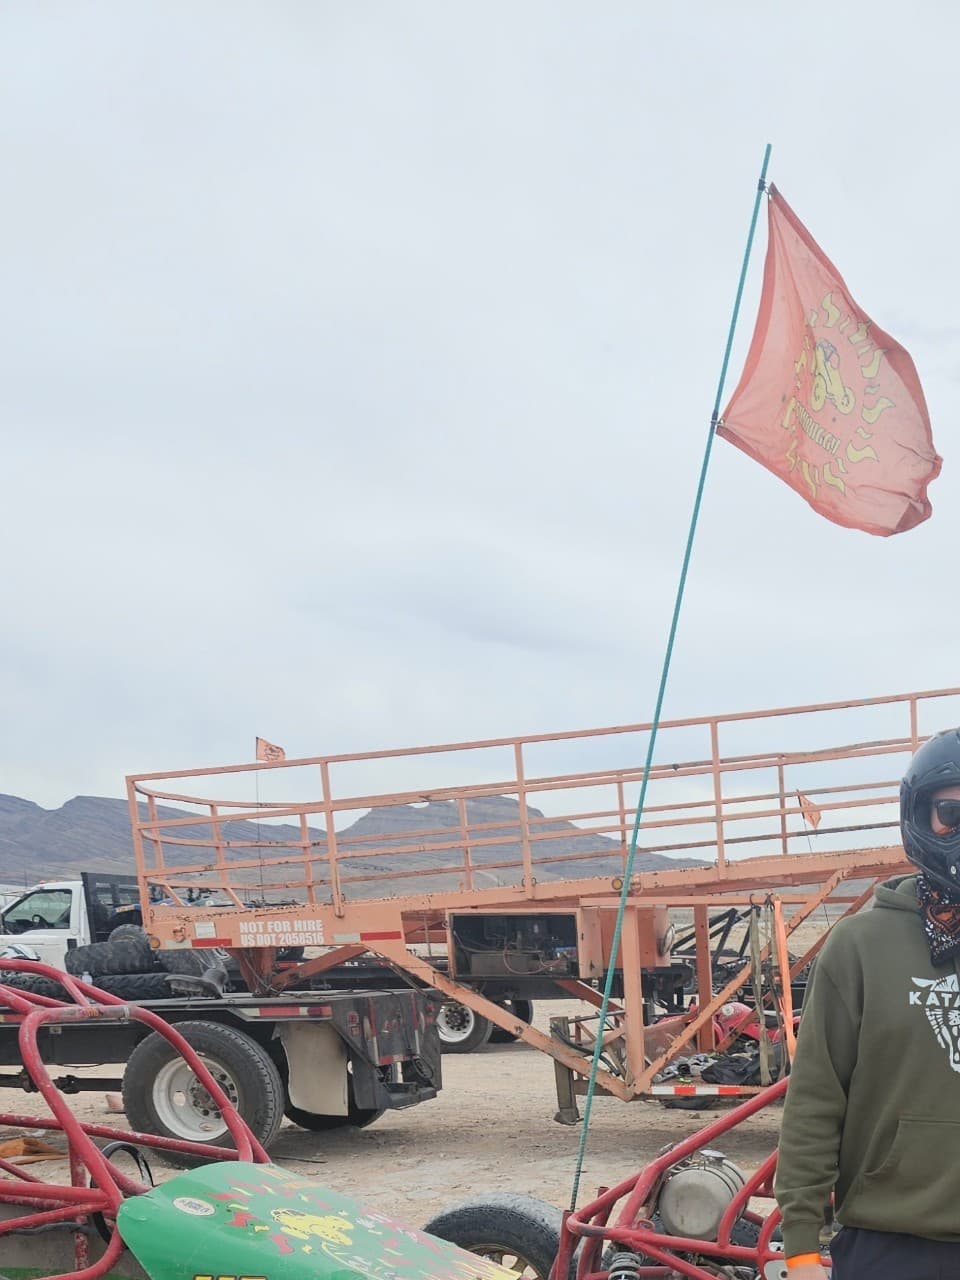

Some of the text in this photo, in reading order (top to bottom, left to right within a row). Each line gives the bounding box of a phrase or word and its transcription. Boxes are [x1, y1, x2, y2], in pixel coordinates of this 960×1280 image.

[240, 919, 323, 933] NOT FOR HIRE
[240, 933, 255, 946] US
[256, 933, 276, 946] DOT
